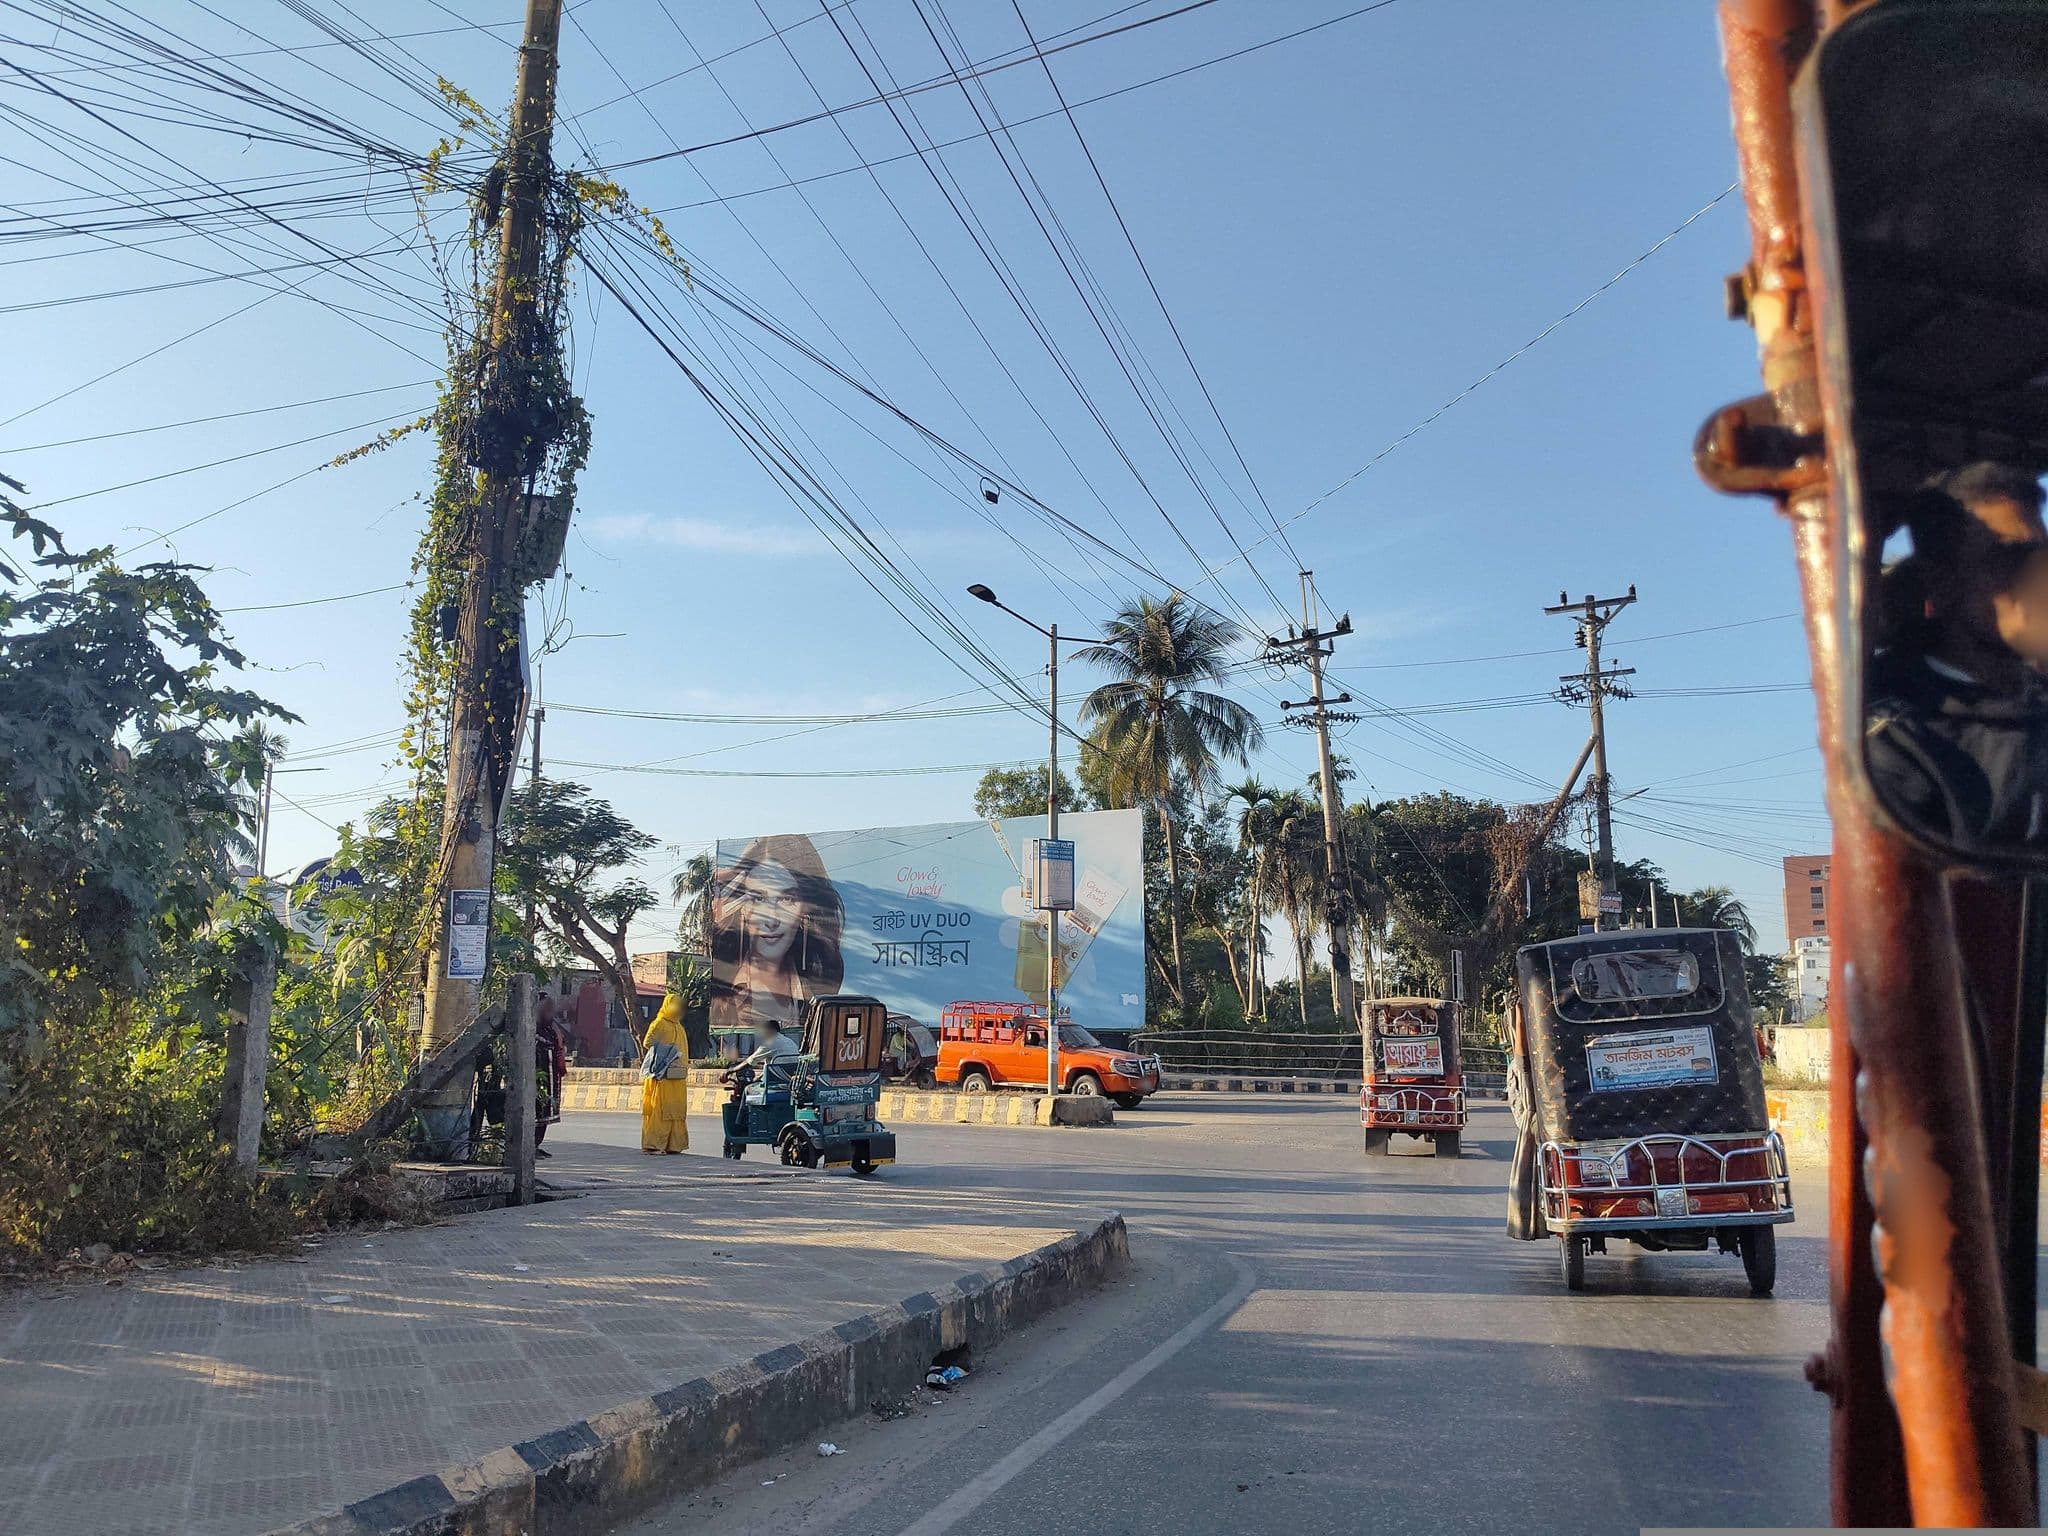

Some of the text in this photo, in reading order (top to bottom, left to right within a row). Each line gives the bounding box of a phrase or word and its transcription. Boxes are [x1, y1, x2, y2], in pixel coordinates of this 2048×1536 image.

[302, 876, 332, 893] Trist
[906, 881, 943, 900] Lovely
[871, 910, 971, 932] ব্রাইট UV DUO
[871, 929, 971, 968] সানস্ক্রিন
[1603, 1047, 1653, 1064] তানজিম
[1655, 1045, 1696, 1059] মটরস
